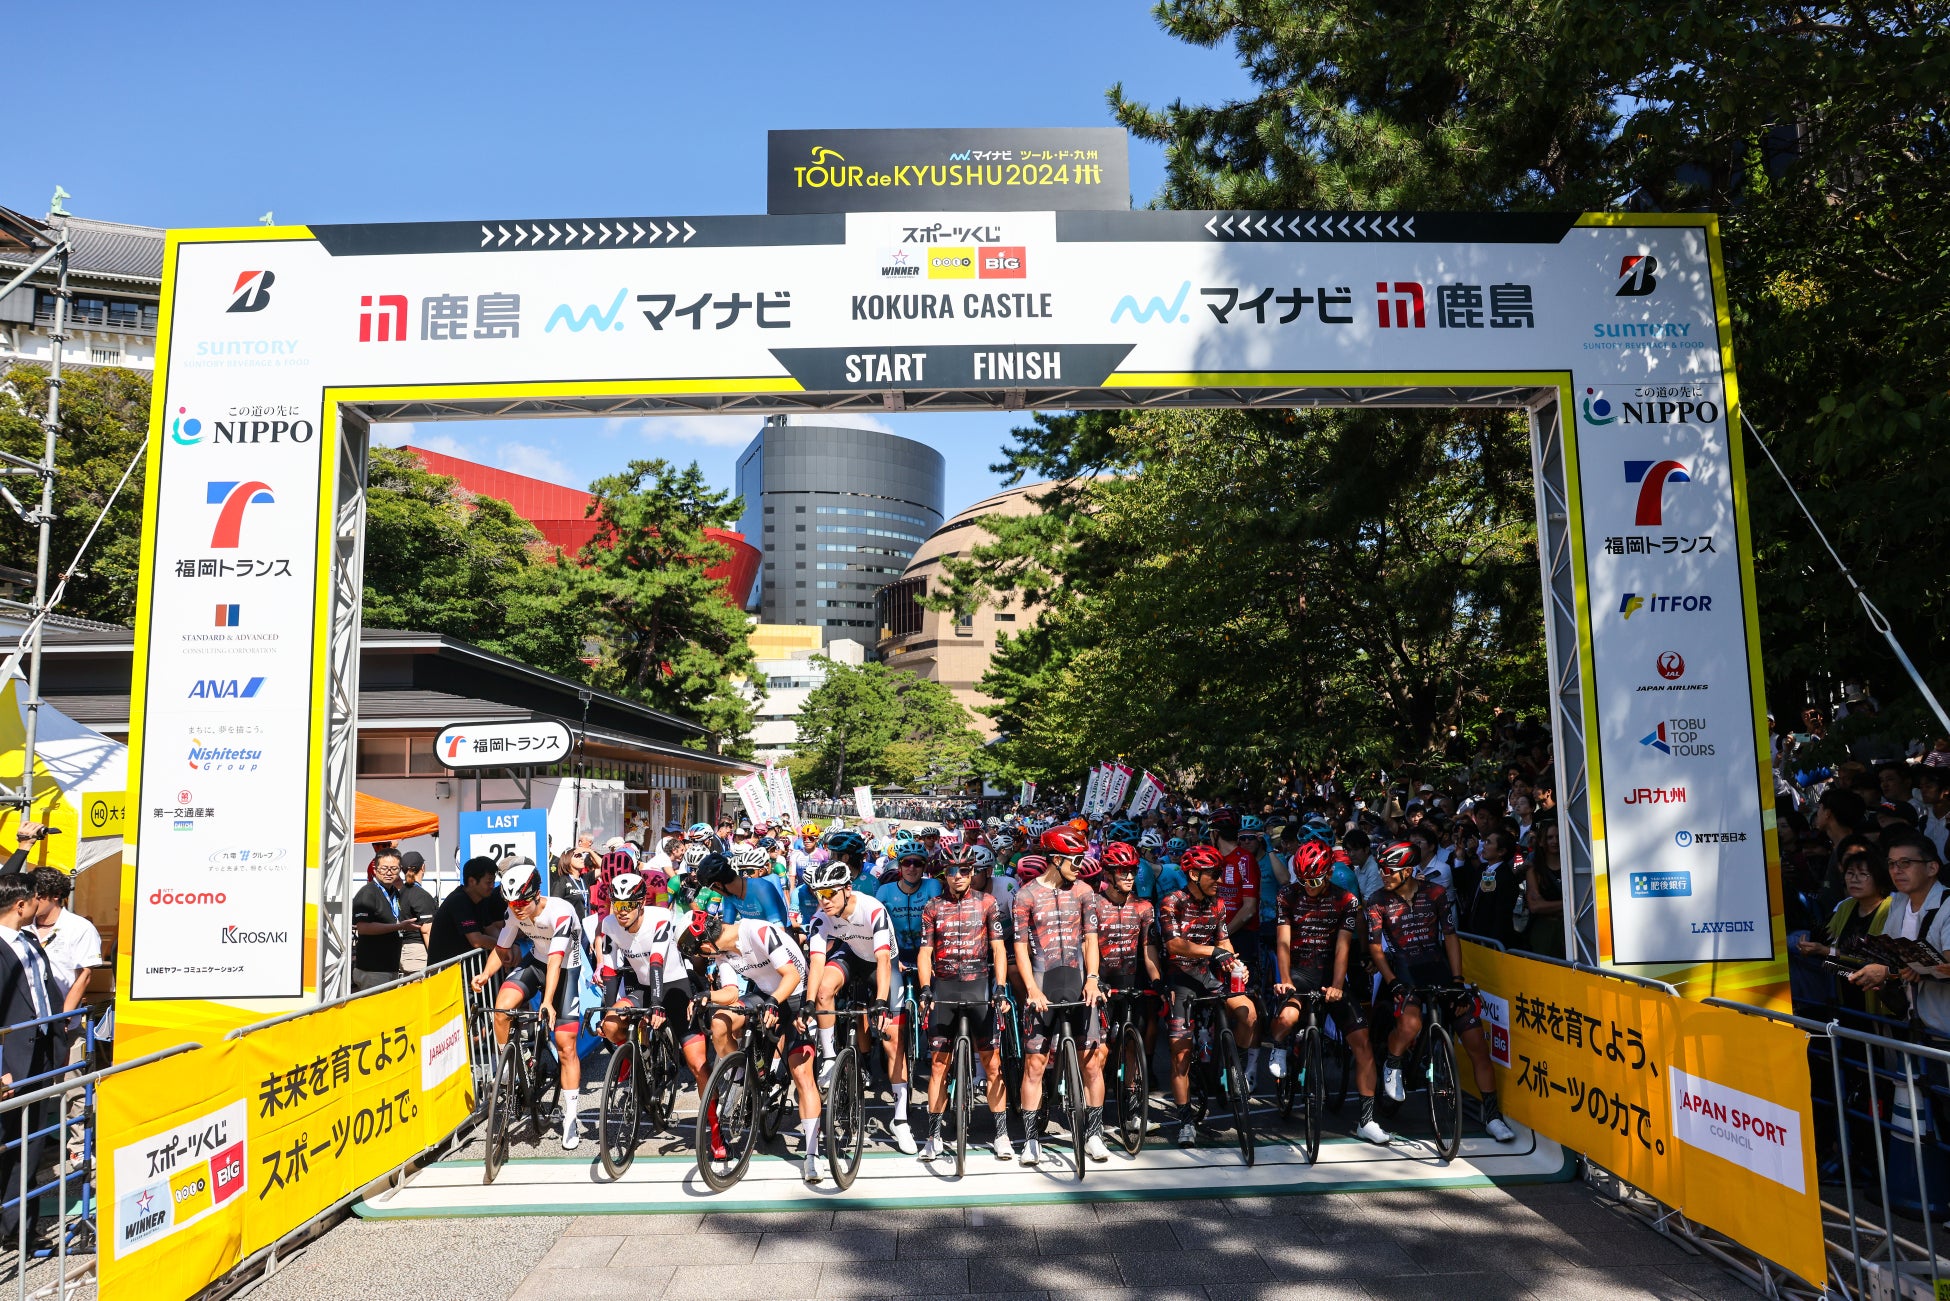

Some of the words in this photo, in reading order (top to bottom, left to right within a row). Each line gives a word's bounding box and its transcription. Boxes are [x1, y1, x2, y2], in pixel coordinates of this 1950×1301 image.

[972, 150, 1012, 161] マイナビ
[1020, 149, 1098, 161] ツール・ド・九州
[794, 165, 864, 188] TOUR
[866, 172, 892, 186] de
[894, 165, 1002, 187] KYUSHU
[1006, 164, 1069, 186] 2024
[902, 223, 1001, 244] スポーツくじ
[881, 266, 920, 276] WINNER
[931, 257, 972, 268] toto
[636, 290, 791, 331] マイナビ
[851, 294, 955, 320] KOKURA
[963, 293, 1052, 319] CASTLE
[1200, 286, 1353, 324] マイナビ
[1437, 282, 1535, 329] 鹿島
[420, 291, 520, 341] 鹿島
[1680, 341, 1704, 349] FOOD
[845, 352, 927, 383] START
[973, 351, 1061, 380] FINISH
[1634, 387, 1702, 398] この道の先に
[228, 405, 299, 416] この道の先に
[1622, 401, 1718, 424] NIPPO
[213, 420, 313, 444] NIPPO
[1604, 536, 1716, 554] 福岡トランス
[175, 559, 292, 577] 福岡トランス
[181, 634, 225, 642] STANDARD
[235, 633, 279, 641] ADVANCED
[188, 680, 239, 698] ANA
[1670, 718, 1706, 730] TOBU
[473, 735, 560, 753] 福岡トランス
[1671, 731, 1698, 743] TOP
[188, 748, 262, 760] Nishitetsu
[1672, 744, 1715, 757] TOURS
[203, 763, 257, 772] Group
[1111, 774, 1123, 800] NIPPO
[1624, 787, 1687, 804] JR九州
[1138, 785, 1154, 812] NIPPO
[94, 808, 105, 820] HQ
[153, 808, 214, 818] 第一交通産業
[487, 815, 519, 828] LAST
[1695, 832, 1747, 843] NTT西日本
[1650, 880, 1687, 890] 肥後銀行
[149, 889, 227, 905] docomo
[222, 925, 287, 943] KROSAKI
[1691, 921, 1754, 934] LAWSON
[146, 966, 181, 975] LINEヤフー
[184, 965, 244, 973] コミュニケーションズ
[1515, 991, 1658, 1077] 未来を育てよう、
[259, 1026, 416, 1118] 未来を育てよう、
[1517, 1054, 1665, 1155] スポーツの力で。
[1680, 1089, 1727, 1123] JAPAN
[1731, 1109, 1788, 1147] SPORT
[259, 1089, 418, 1201] スポーツの力で。
[1709, 1124, 1754, 1151] COUNCIL
[146, 1120, 227, 1178] スポーツくじ
[175, 1177, 206, 1203] toto
[125, 1210, 166, 1240] WINNER
